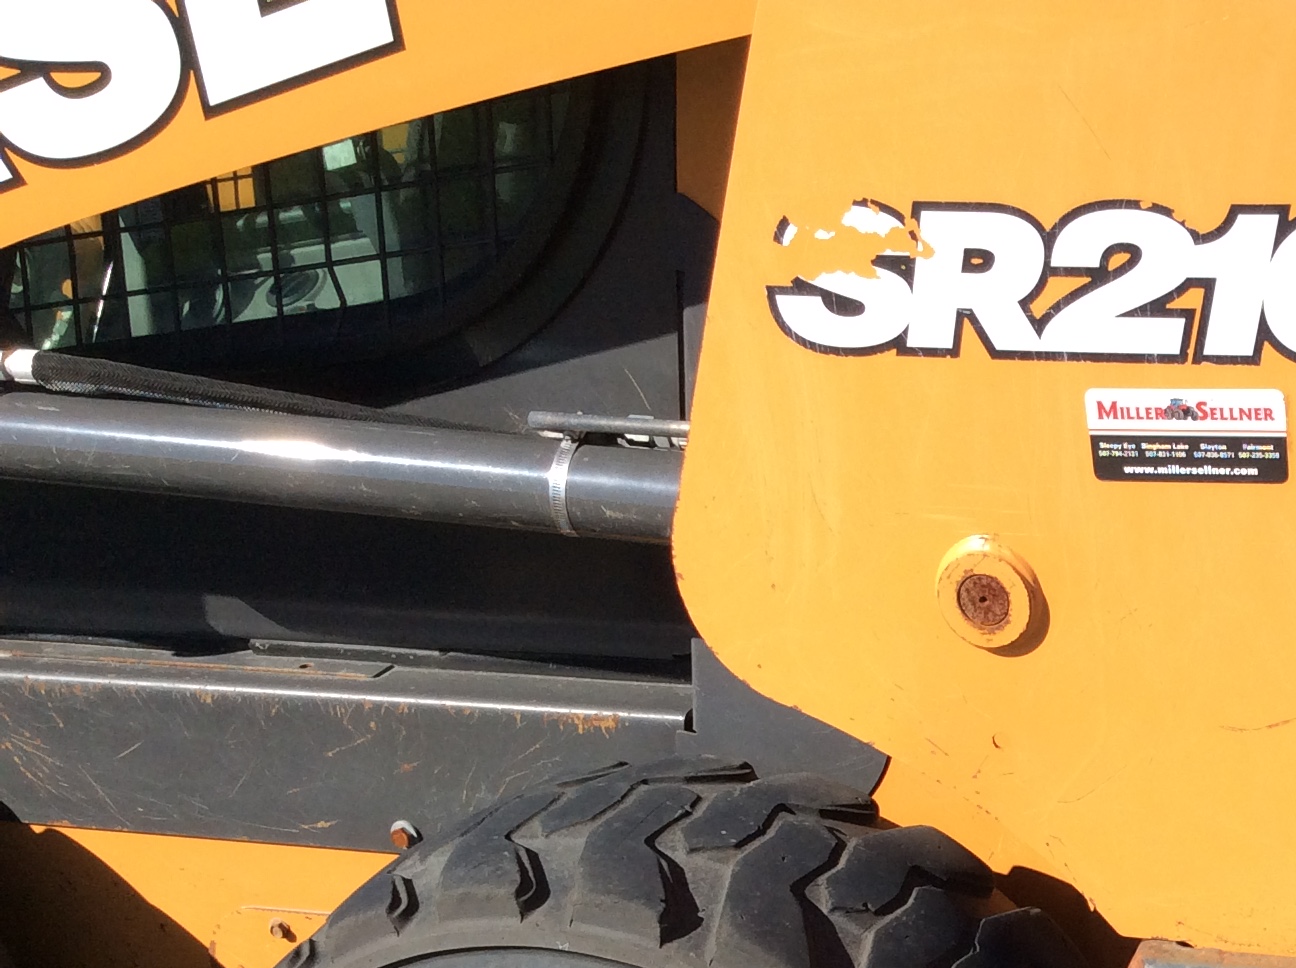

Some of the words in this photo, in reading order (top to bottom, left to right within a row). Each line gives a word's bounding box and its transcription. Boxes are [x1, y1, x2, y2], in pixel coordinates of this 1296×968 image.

[1096, 400, 1167, 420] MILLER
[1195, 402, 1275, 421] SELLNER
[1123, 464, 1259, 476] www.millersellner.com
